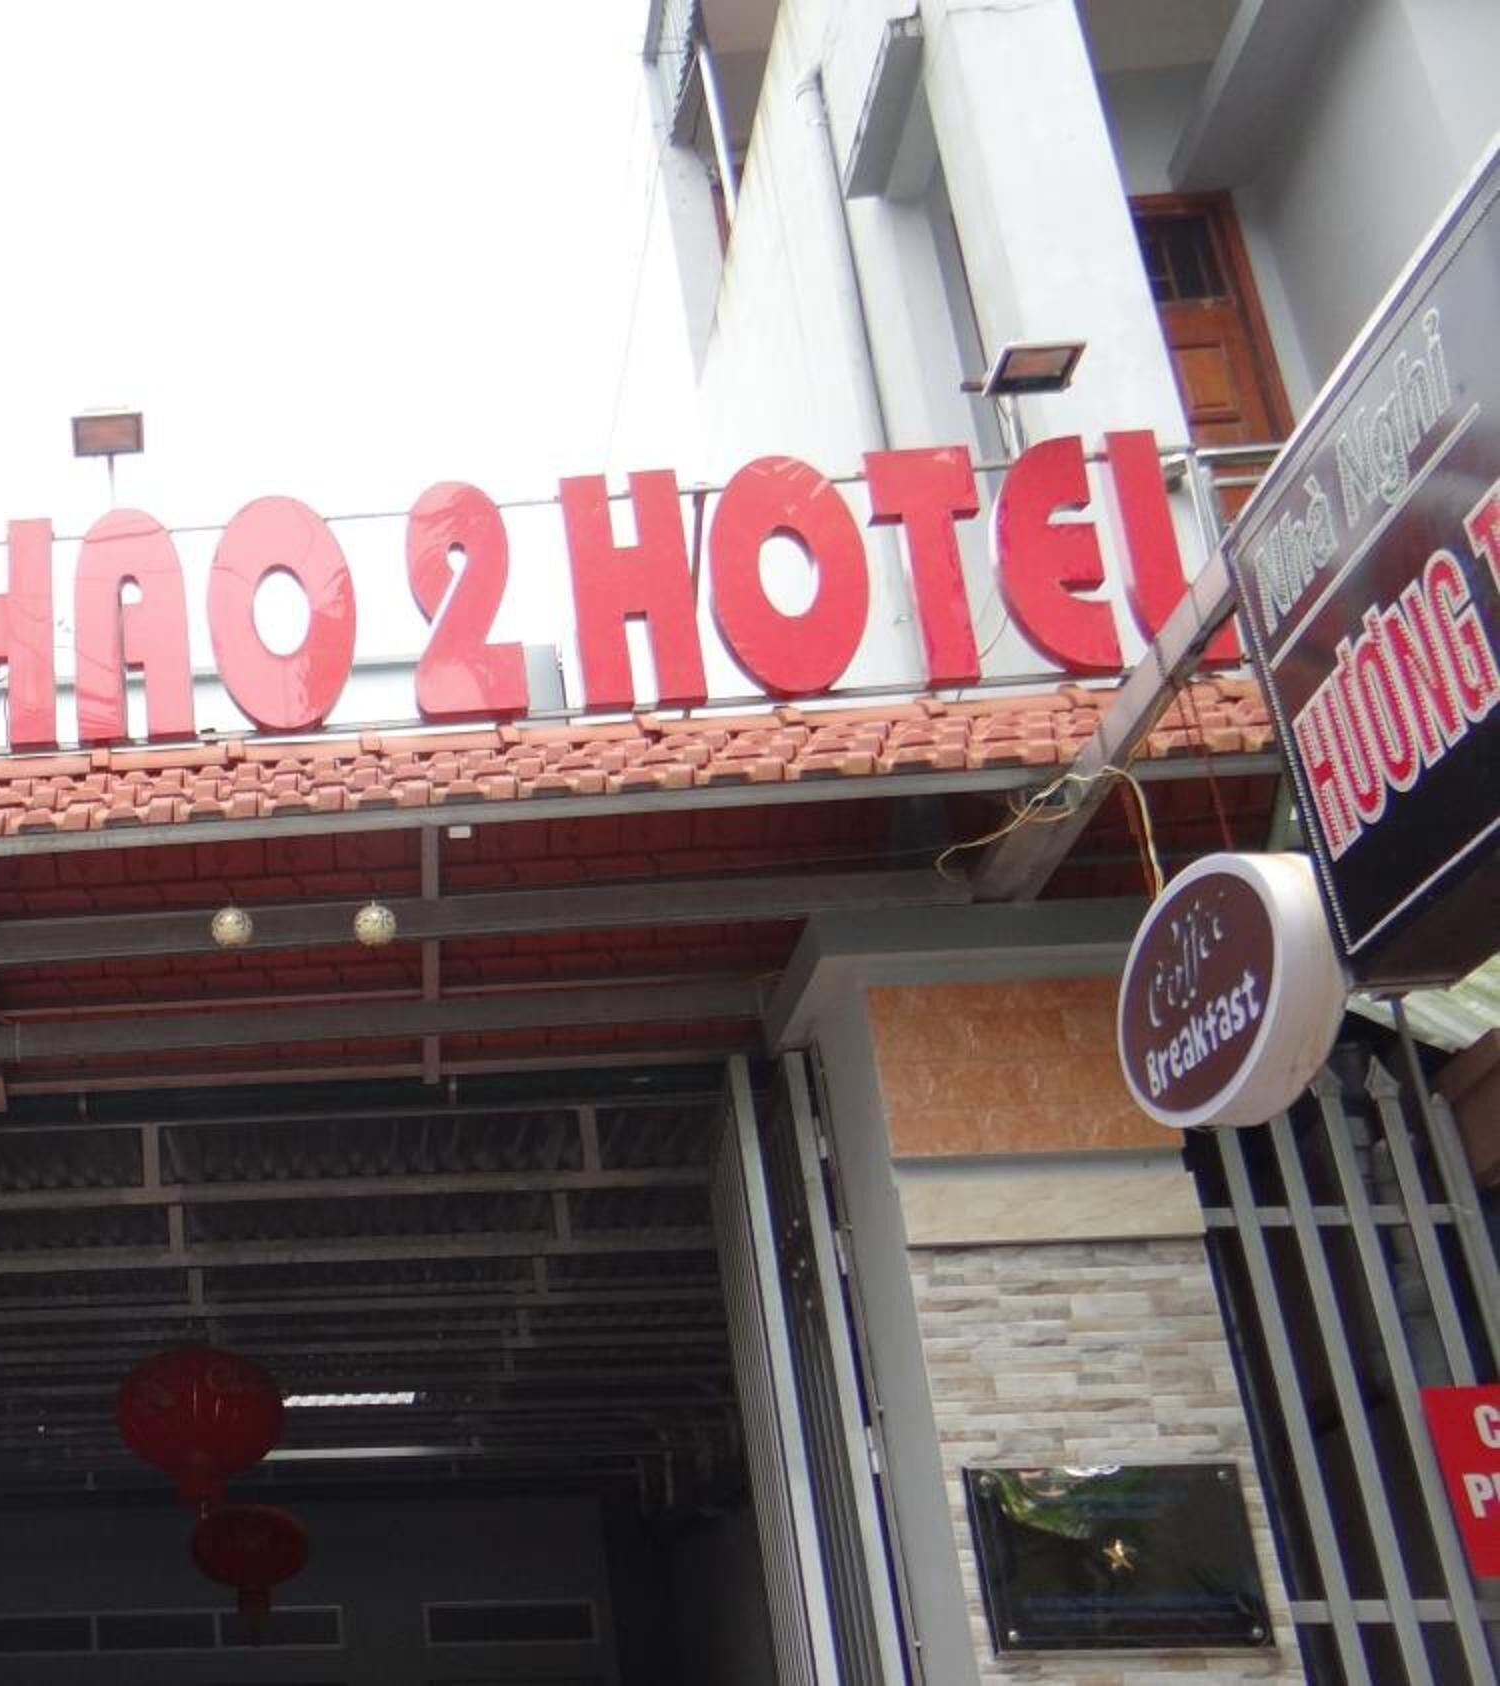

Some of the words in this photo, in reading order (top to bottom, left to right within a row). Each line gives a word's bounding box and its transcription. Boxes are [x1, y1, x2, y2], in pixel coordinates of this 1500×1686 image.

[405, 480, 530, 723] 2
[558, 429, 1241, 714] HOTEL
[1253, 473, 1340, 638] Nhà
[1334, 307, 1452, 530] Nghỉ
[1145, 968, 1261, 1099] Breakfast
